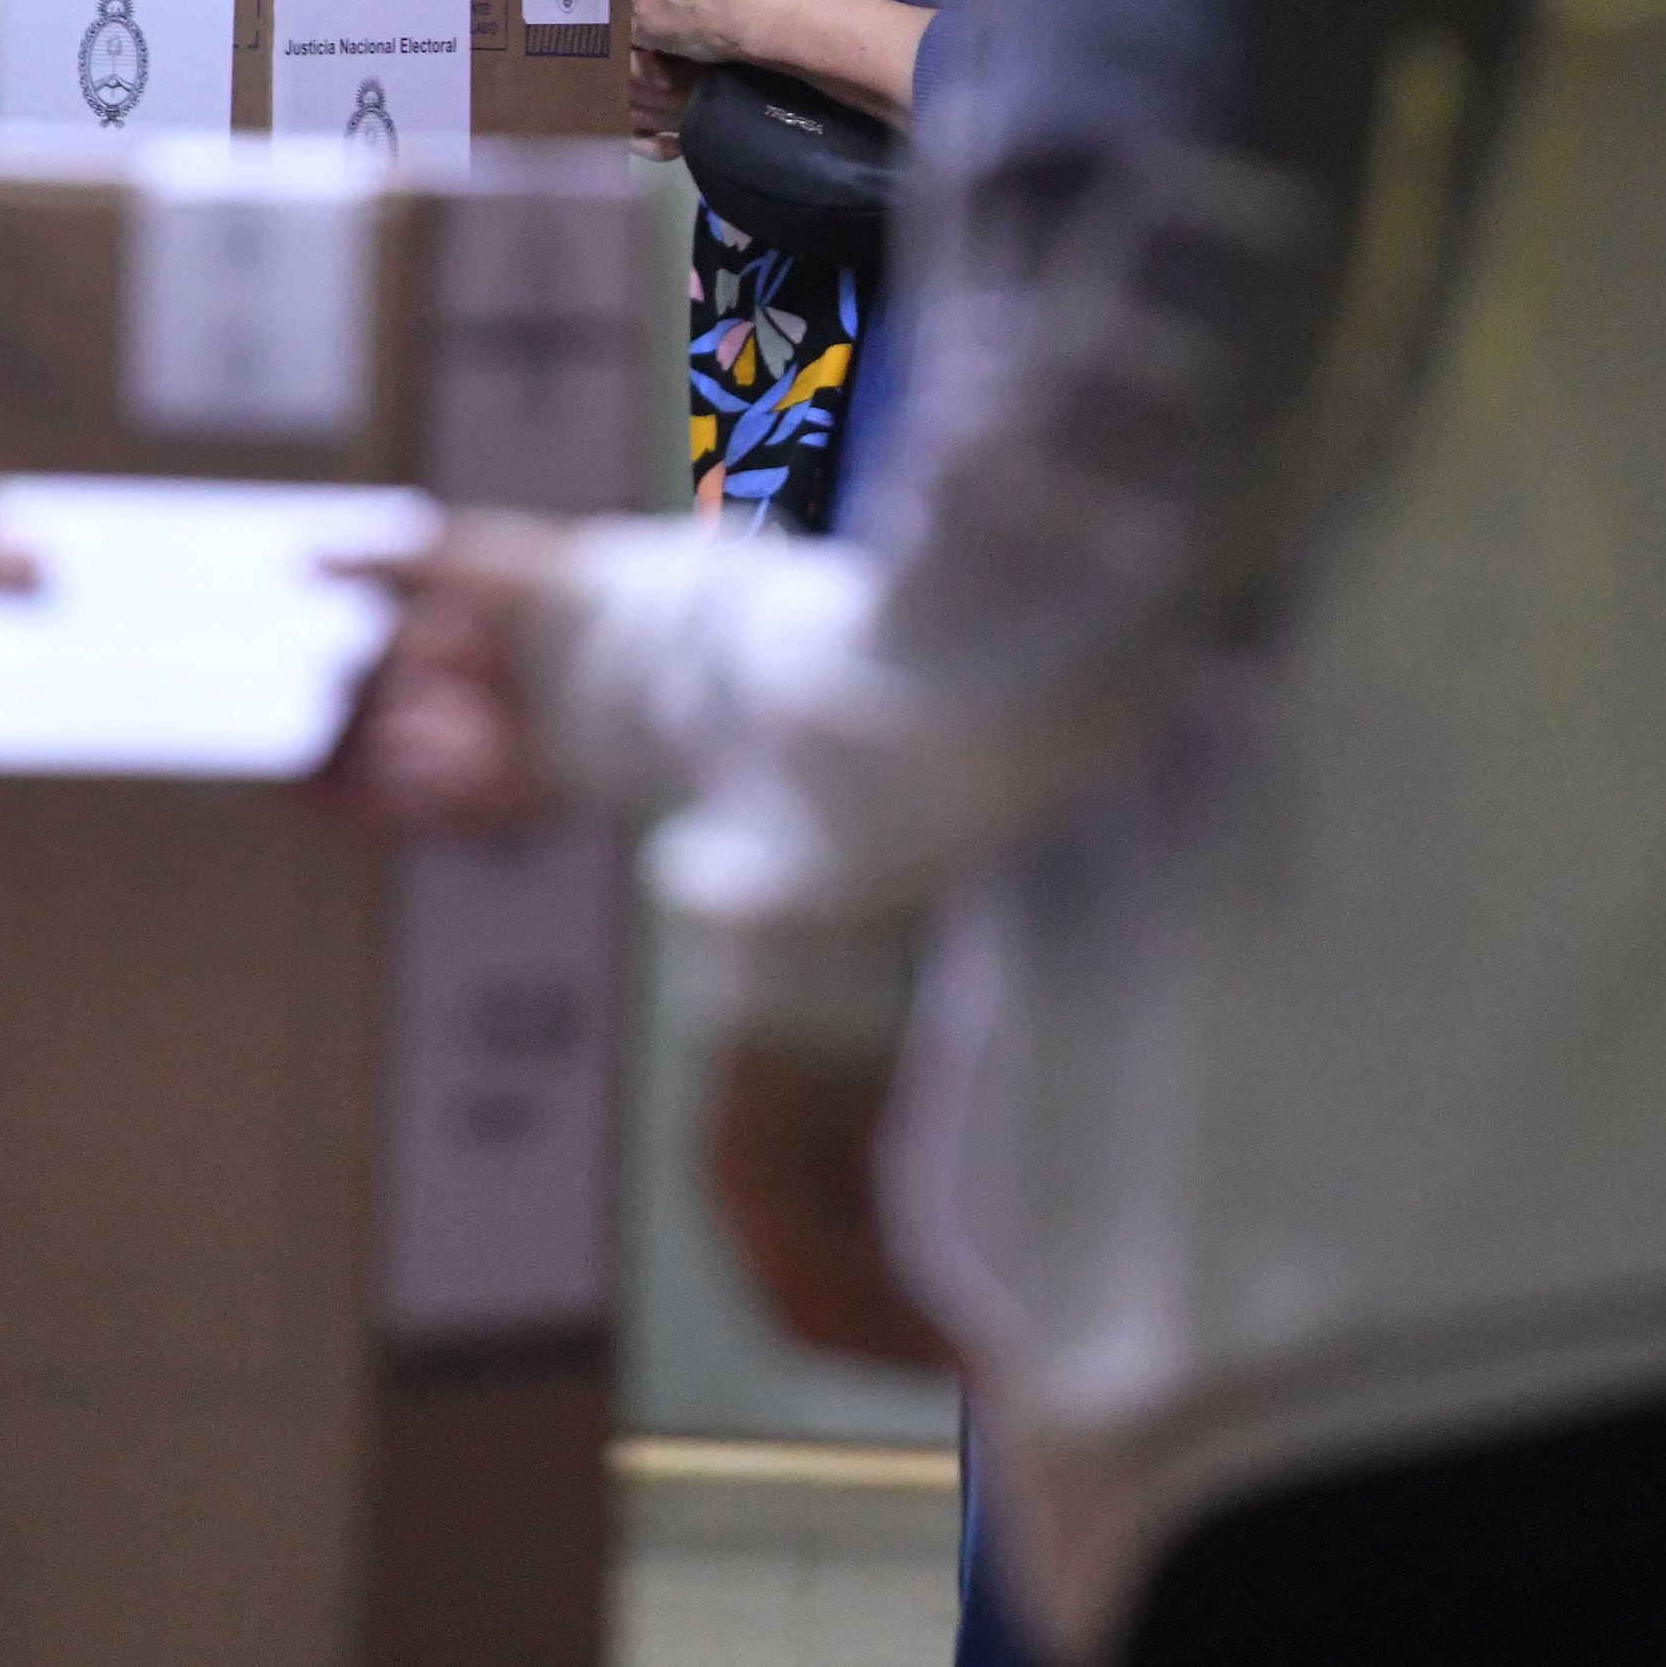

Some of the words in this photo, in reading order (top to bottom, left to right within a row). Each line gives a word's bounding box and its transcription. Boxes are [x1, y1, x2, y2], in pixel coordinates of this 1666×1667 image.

[284, 38, 336, 56] Justicia
[339, 37, 396, 55] Nacional
[399, 36, 457, 54] Electoral
